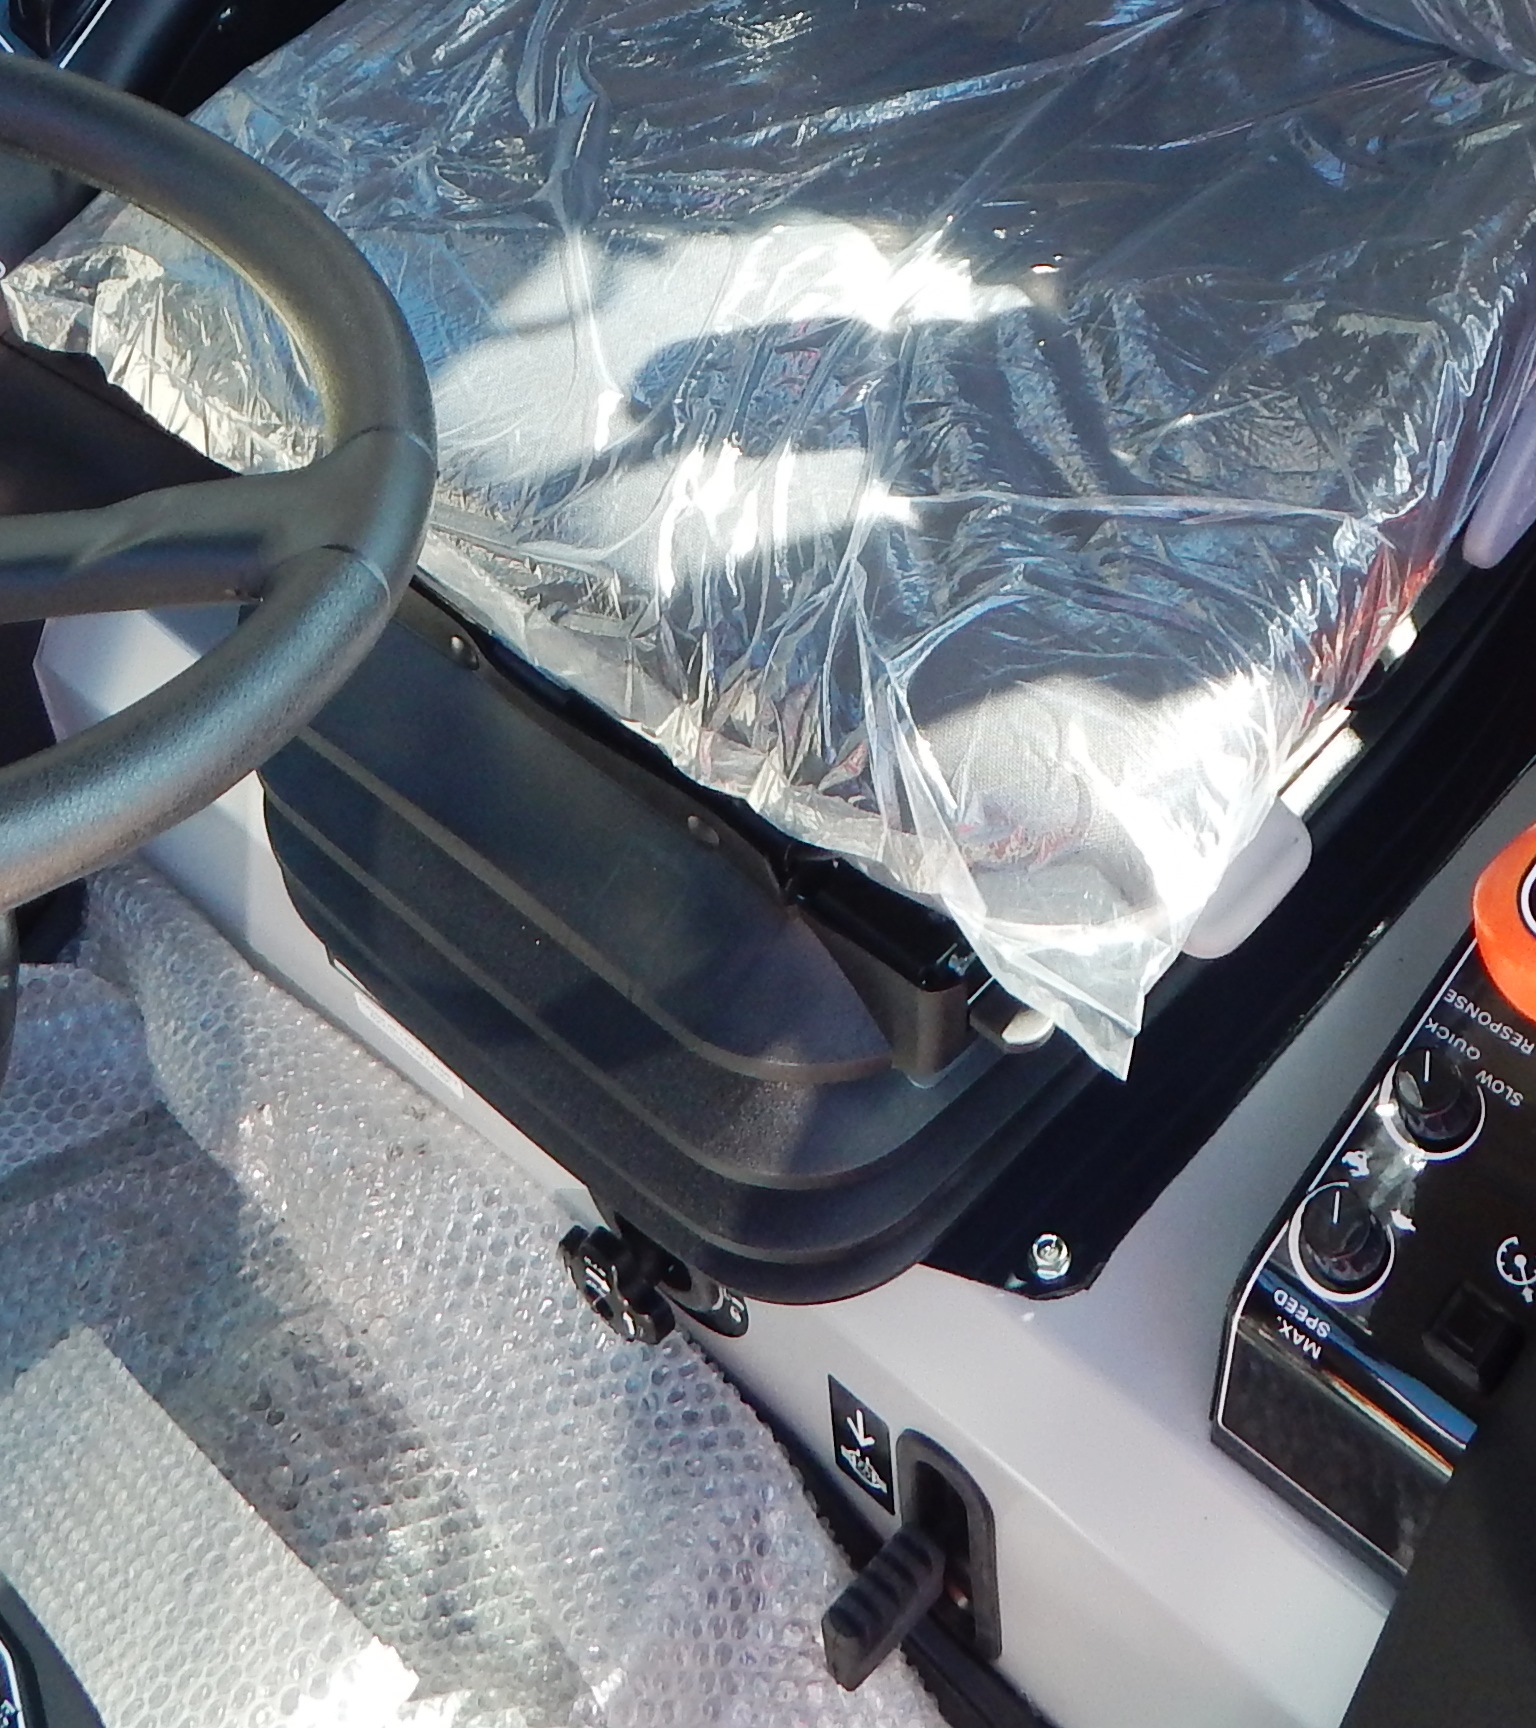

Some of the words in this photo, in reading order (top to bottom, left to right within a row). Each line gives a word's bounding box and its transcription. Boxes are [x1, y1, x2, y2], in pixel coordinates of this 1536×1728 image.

[1423, 1016, 1480, 1060] QUICK
[1441, 987, 1535, 1055] RESPONSE
[1473, 1067, 1523, 1107] SLOW
[1270, 1287, 1330, 1339] SPEED
[1275, 1315, 1322, 1359] MAX.
